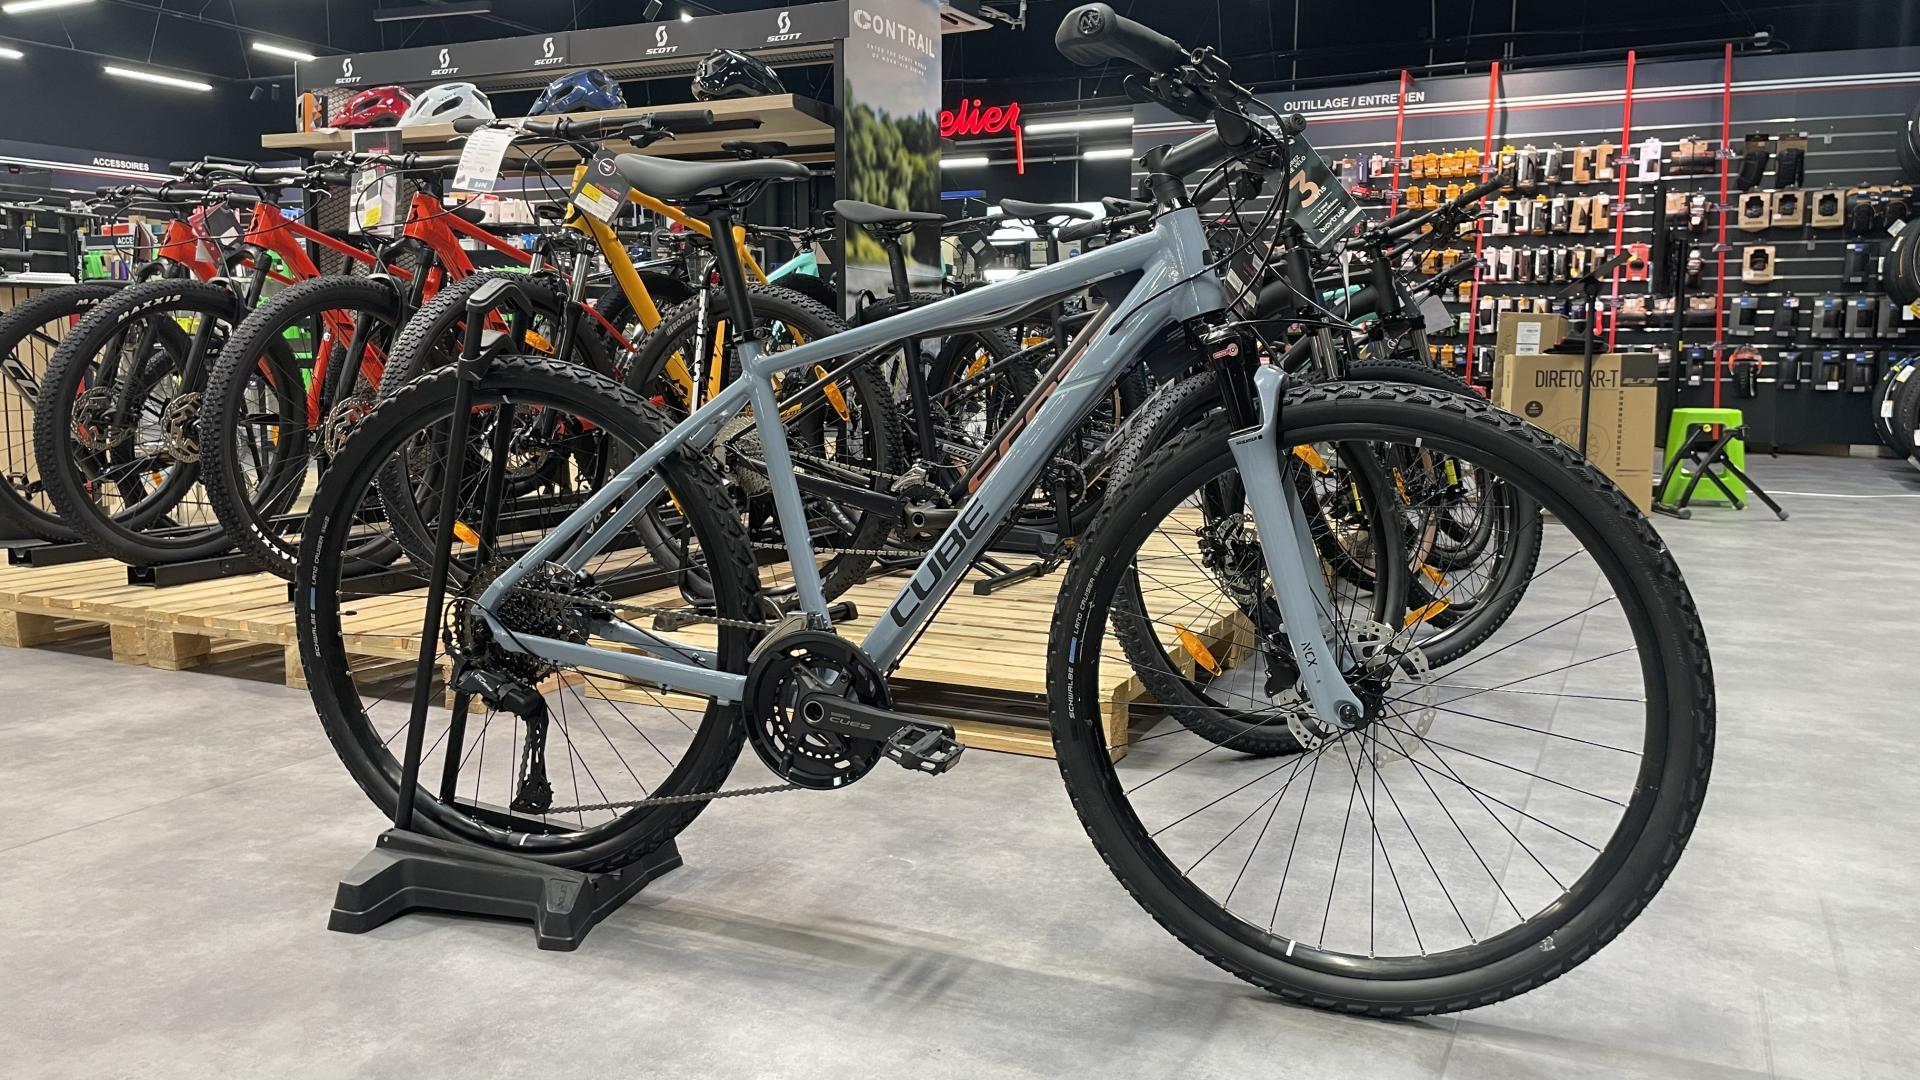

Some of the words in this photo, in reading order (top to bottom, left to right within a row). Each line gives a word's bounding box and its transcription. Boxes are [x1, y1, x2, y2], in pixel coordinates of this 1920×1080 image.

[766, 32, 802, 43] SCOTT
[853, 9, 936, 59] CONTRAIL
[646, 46, 679, 55] SCOTT
[431, 67, 459, 76] SCOTT
[534, 57, 564, 66] SCOTT
[335, 76, 362, 85] SCOTT
[1284, 97, 1349, 111] OUTILLAGE
[93, 157, 150, 171] ACCESSOIRES
[1289, 169, 1320, 209] 3
[118, 294, 182, 323] MAXXIS
[672, 308, 700, 330] BOOSTE
[1535, 369, 1584, 388] DIRETO
[1589, 369, 1619, 388] XR-T
[314, 534, 325, 565] CRUISER
[890, 496, 990, 628] CUBE
[311, 566, 319, 586] LAND
[310, 612, 322, 658] SCHWALBE
[1068, 665, 1076, 720] SCHWALBE
[1073, 611, 1083, 635] LAND
[1080, 576, 1096, 611] CRUISER
[1301, 641, 1318, 668] NCX
[829, 715, 873, 731] CUES
